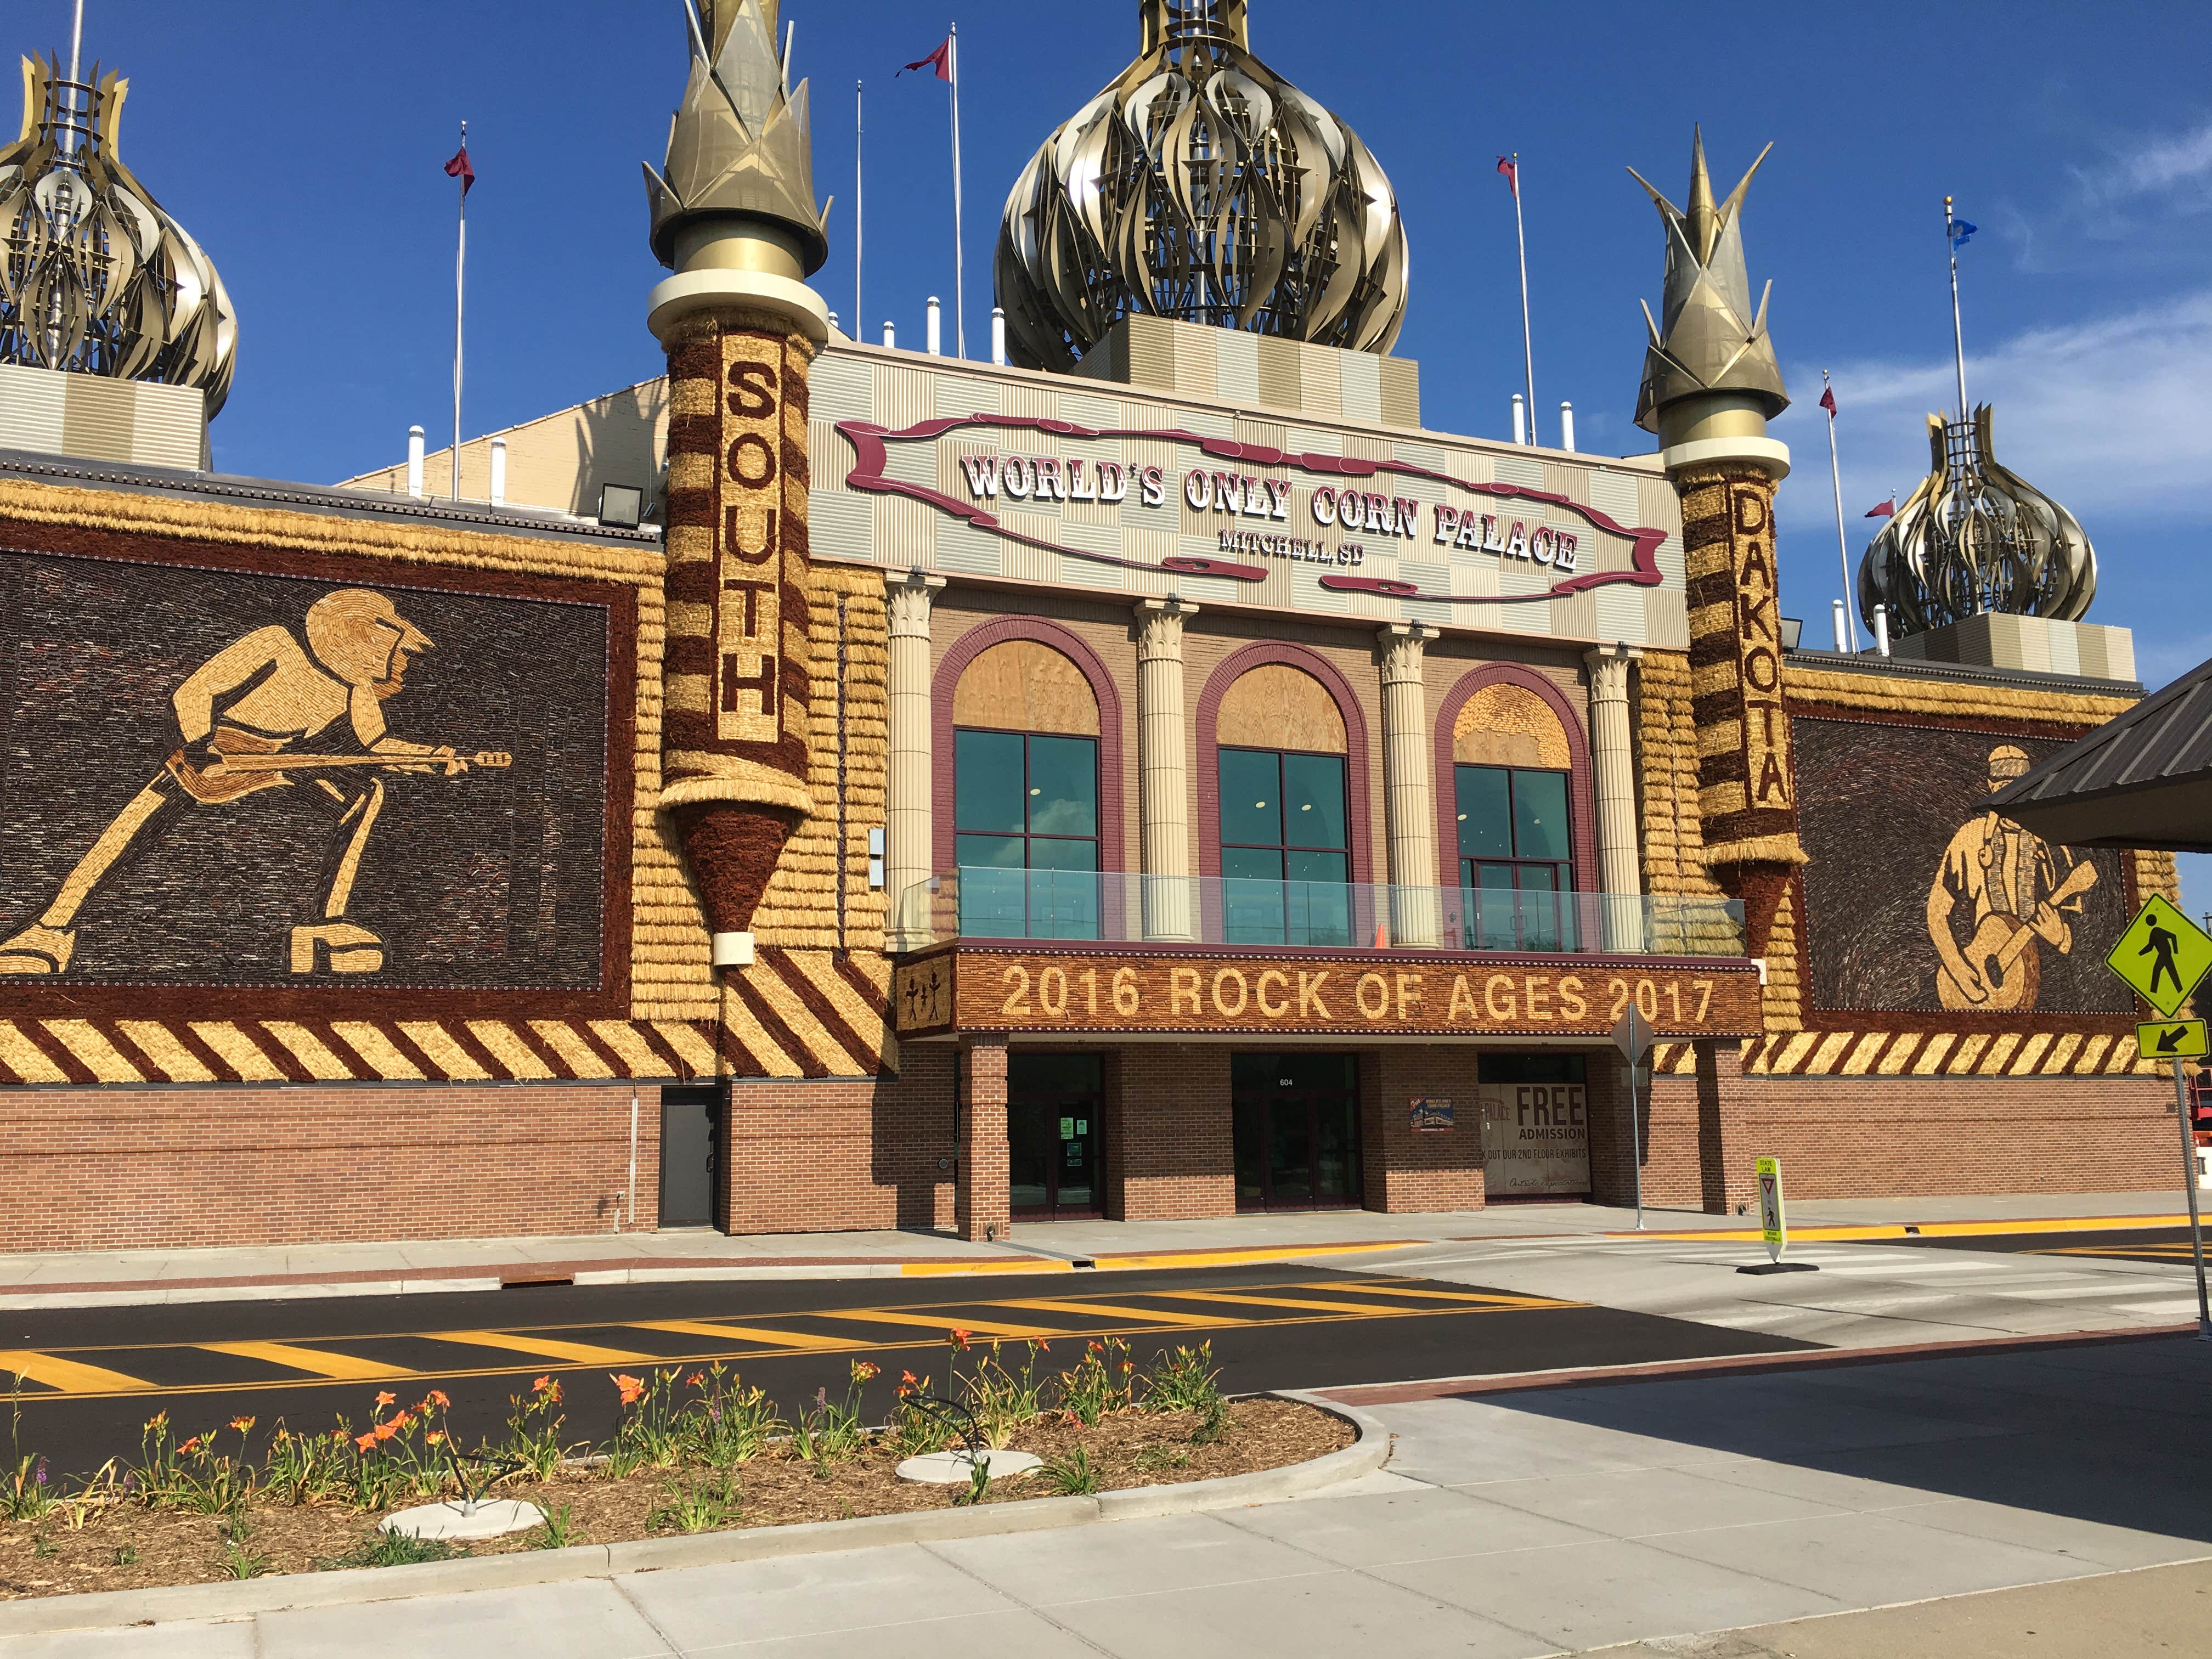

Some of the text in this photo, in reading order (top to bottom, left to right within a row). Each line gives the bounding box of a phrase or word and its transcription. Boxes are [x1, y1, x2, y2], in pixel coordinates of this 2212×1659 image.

[961, 454, 1578, 570] WORLD'S ONLY CORN PALACE
[723, 360, 776, 715] SOUTH
[1219, 528, 1365, 564] MITCHELL, SD
[1734, 489, 1788, 803] DAKOTA
[1002, 965, 1713, 1023] 2016 ROCK OF AGES 2017
[1485, 1103, 1510, 1121] PALACE
[1516, 1086, 1584, 1126] FREE
[1488, 1149, 1501, 1159] OUT
[1503, 1149, 1516, 1159] OUR
[1518, 1149, 1532, 1159] 2ND
[1533, 1149, 1554, 1159] FLOOR
[1556, 1148, 1587, 1158] EXHIBITS
[1519, 1128, 1585, 1140] ADMISSION
